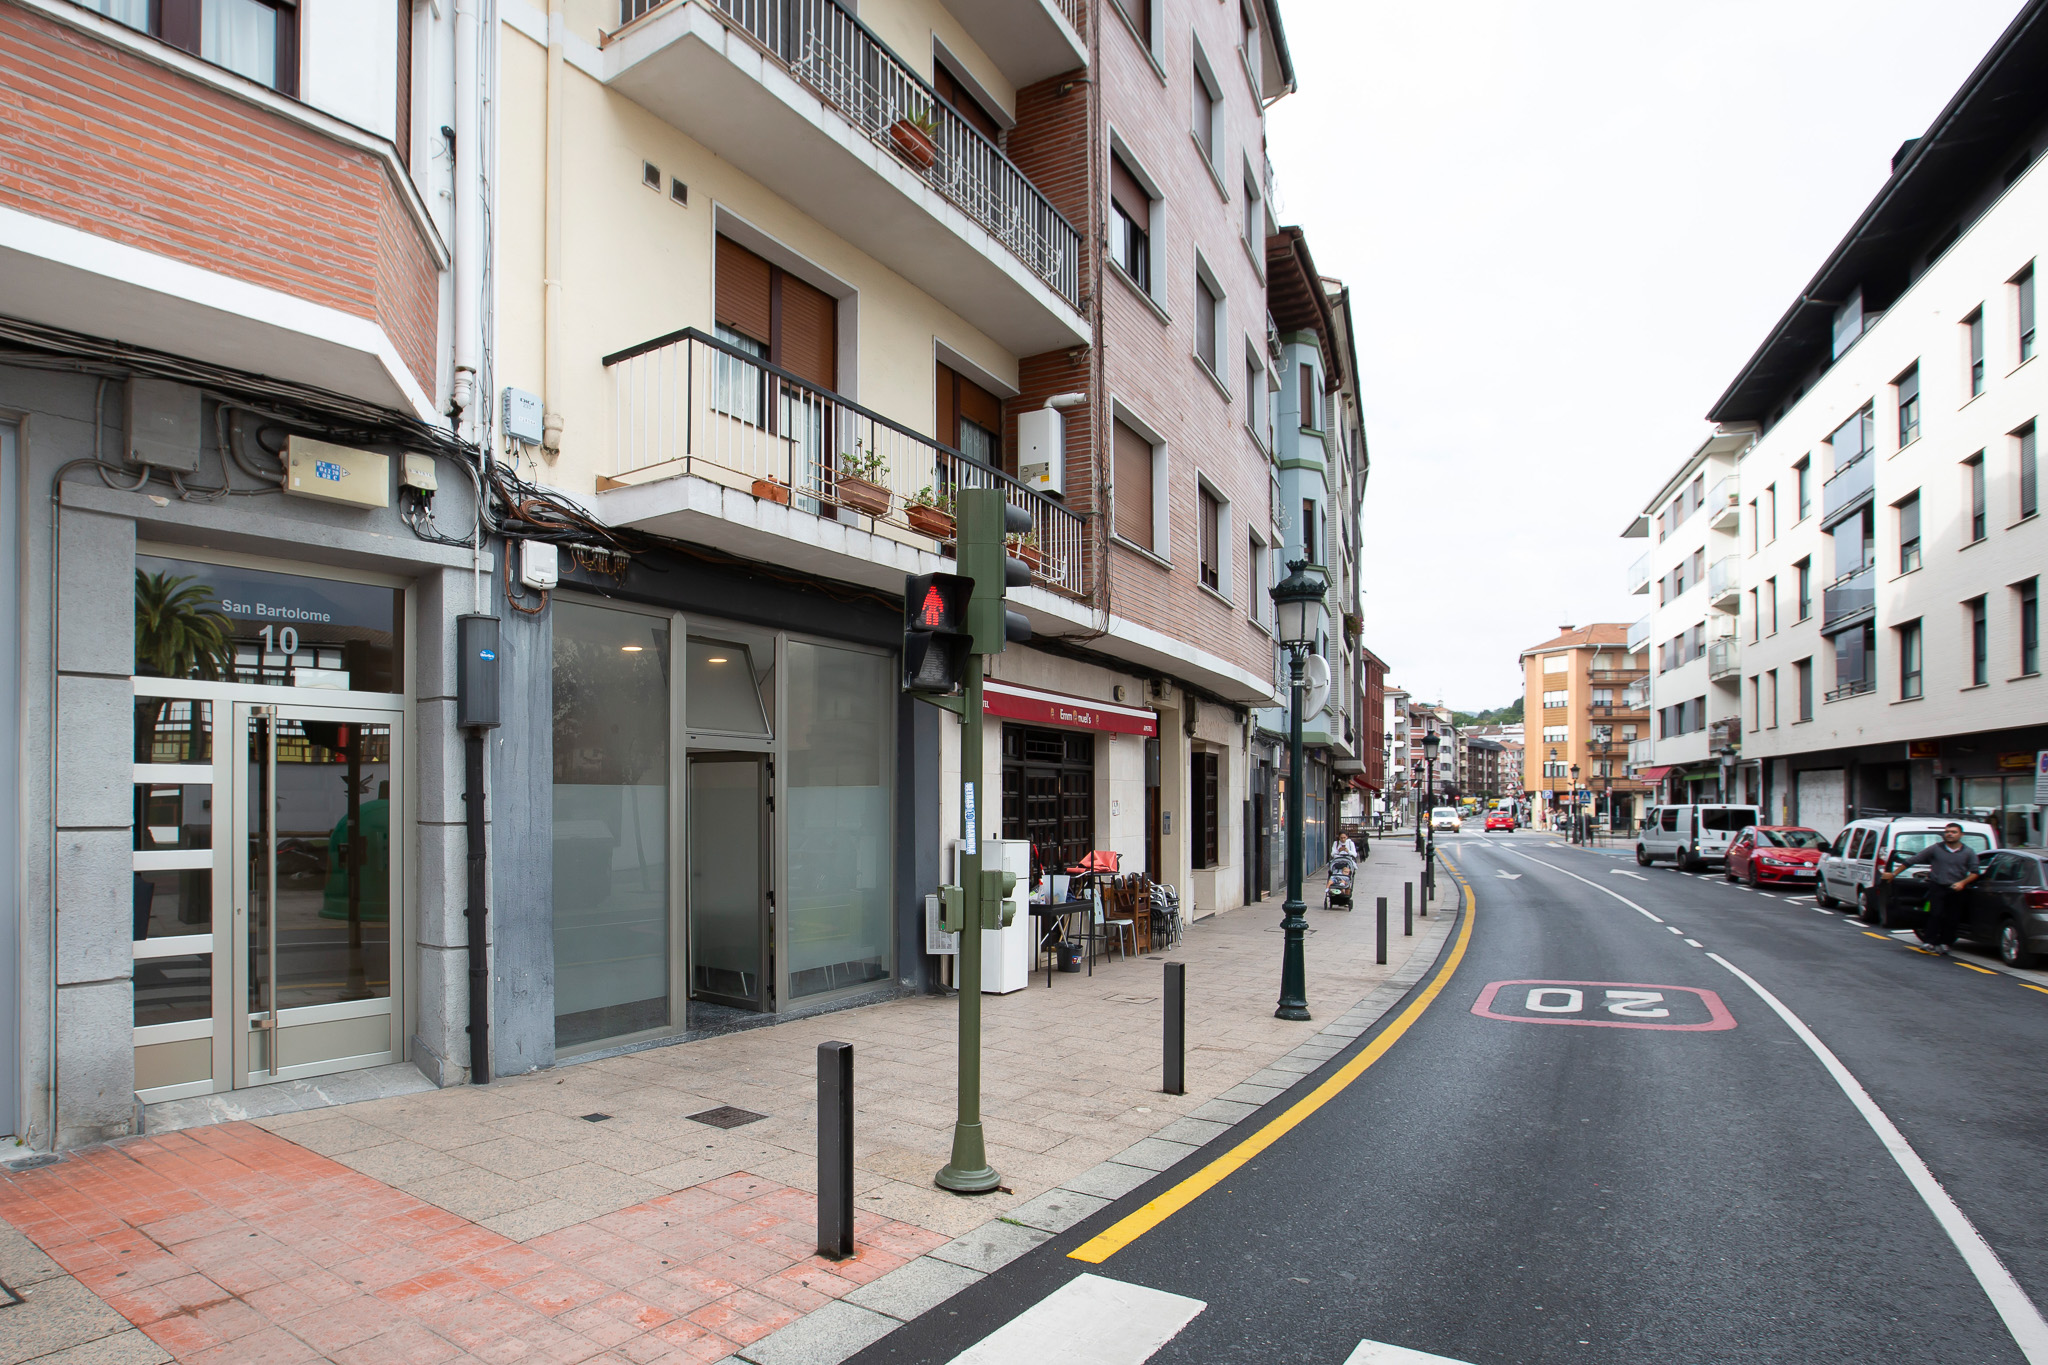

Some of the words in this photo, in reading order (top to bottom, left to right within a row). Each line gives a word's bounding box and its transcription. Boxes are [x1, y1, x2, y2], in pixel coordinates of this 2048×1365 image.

[222, 599, 251, 614] San
[256, 603, 331, 622] Bartolome
[259, 624, 299, 655] 10
[1525, 987, 1670, 1018] 20
